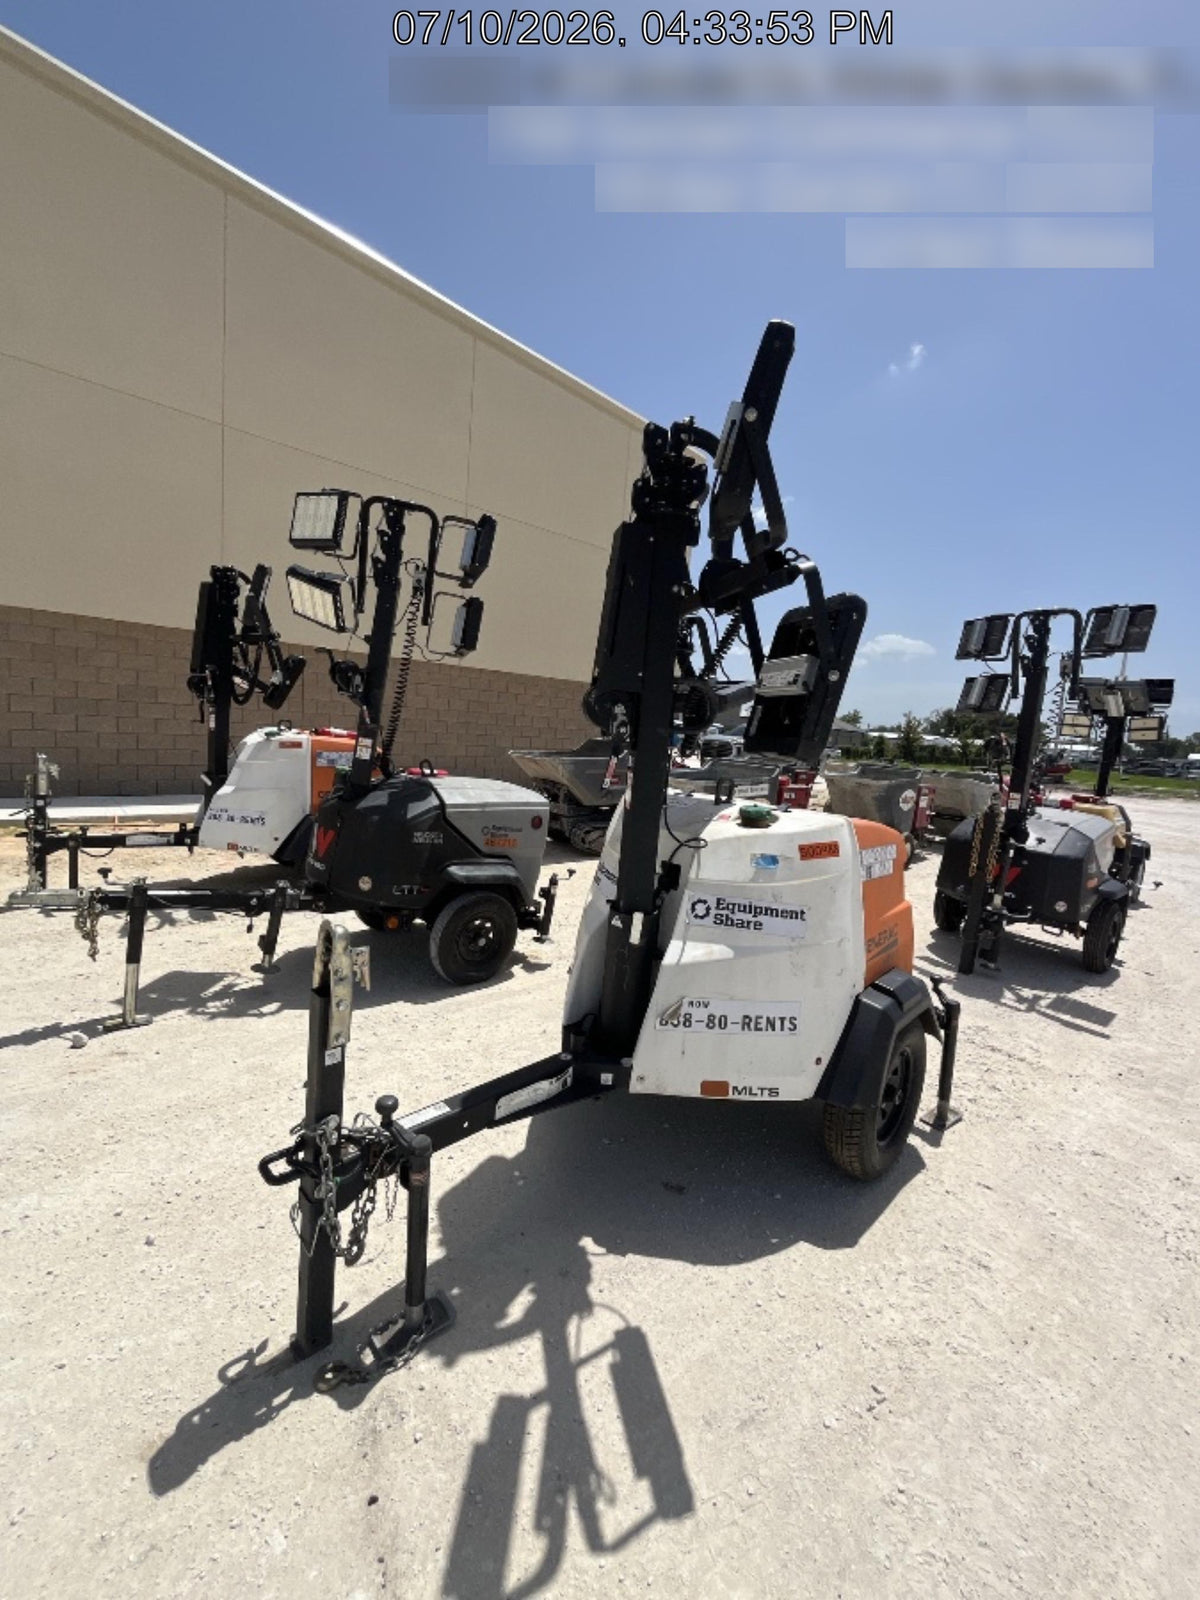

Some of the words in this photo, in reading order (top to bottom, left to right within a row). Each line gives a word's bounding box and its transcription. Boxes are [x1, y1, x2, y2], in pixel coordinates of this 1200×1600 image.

[715, 897, 806, 921] Equipment
[713, 913, 763, 931] Share
[687, 1000, 711, 1009] NOW
[731, 1085, 780, 1097] MLTS
